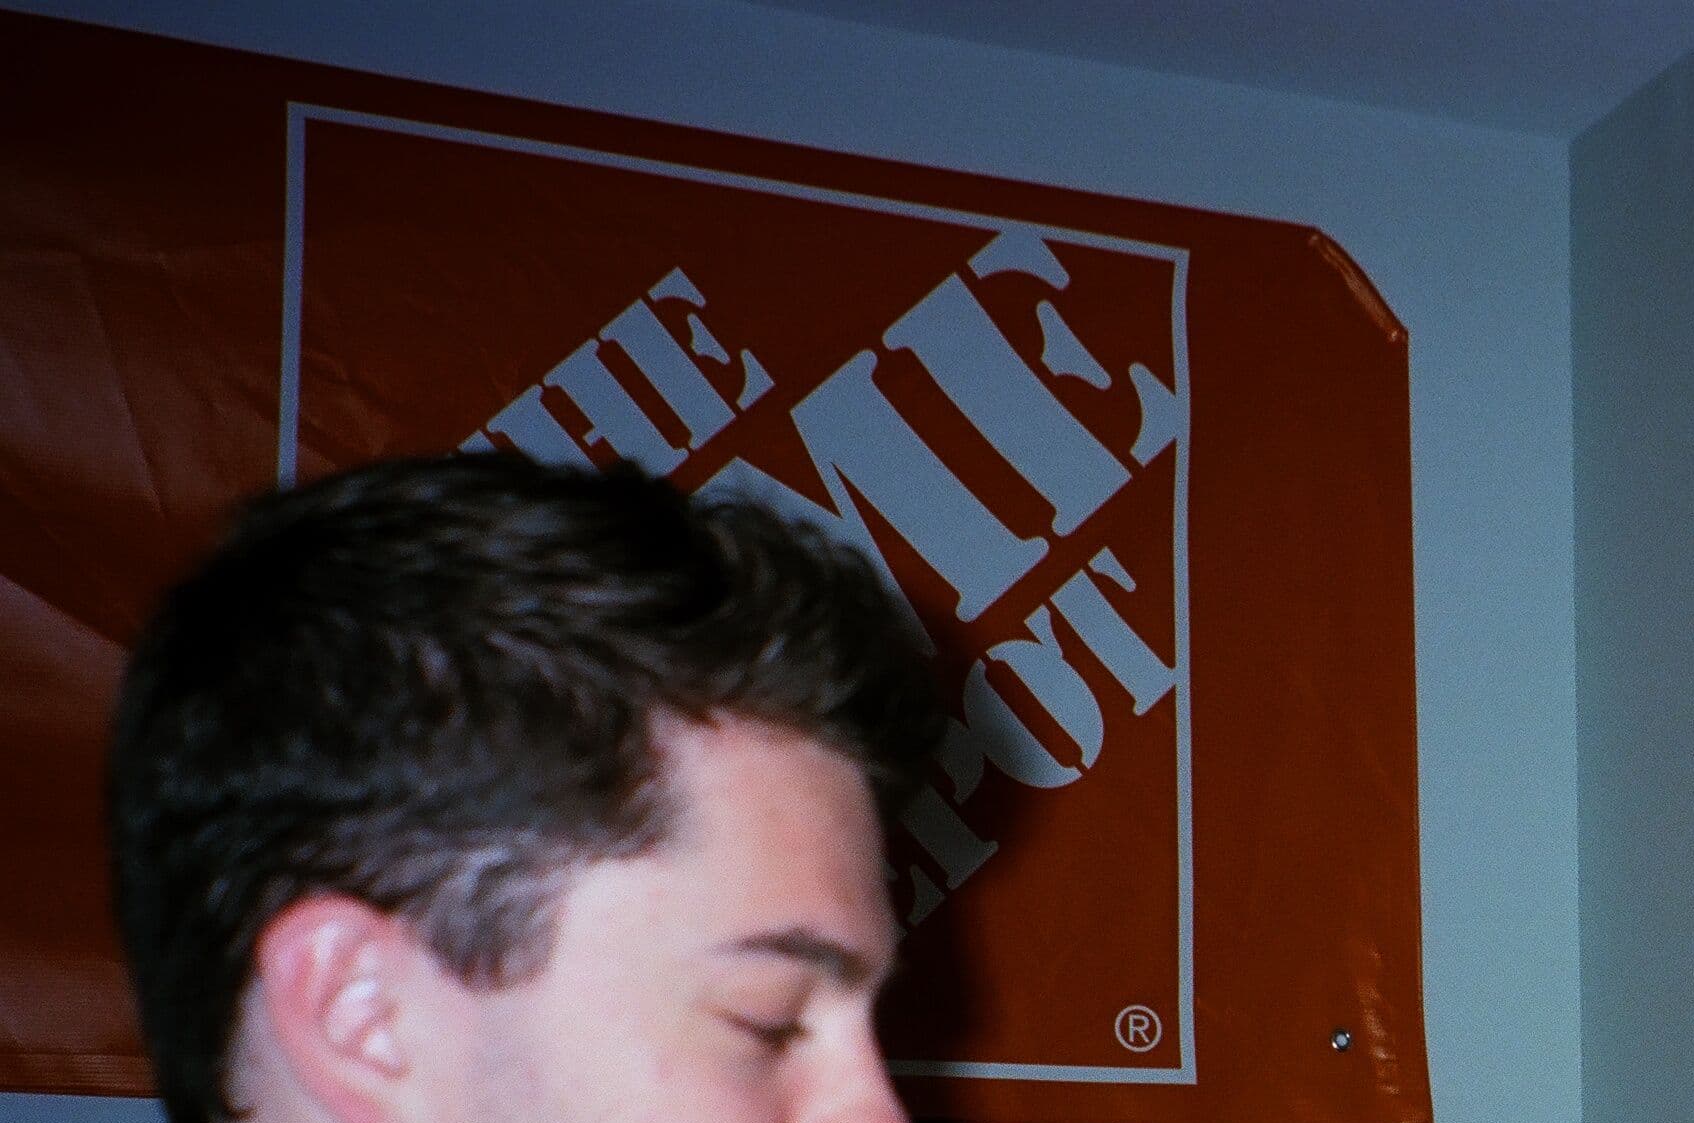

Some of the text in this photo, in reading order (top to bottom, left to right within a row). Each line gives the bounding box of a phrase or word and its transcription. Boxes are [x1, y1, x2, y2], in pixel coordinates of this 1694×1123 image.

[452, 267, 776, 478] HE
[692, 224, 1179, 654] ME
[892, 547, 1176, 937] POT
